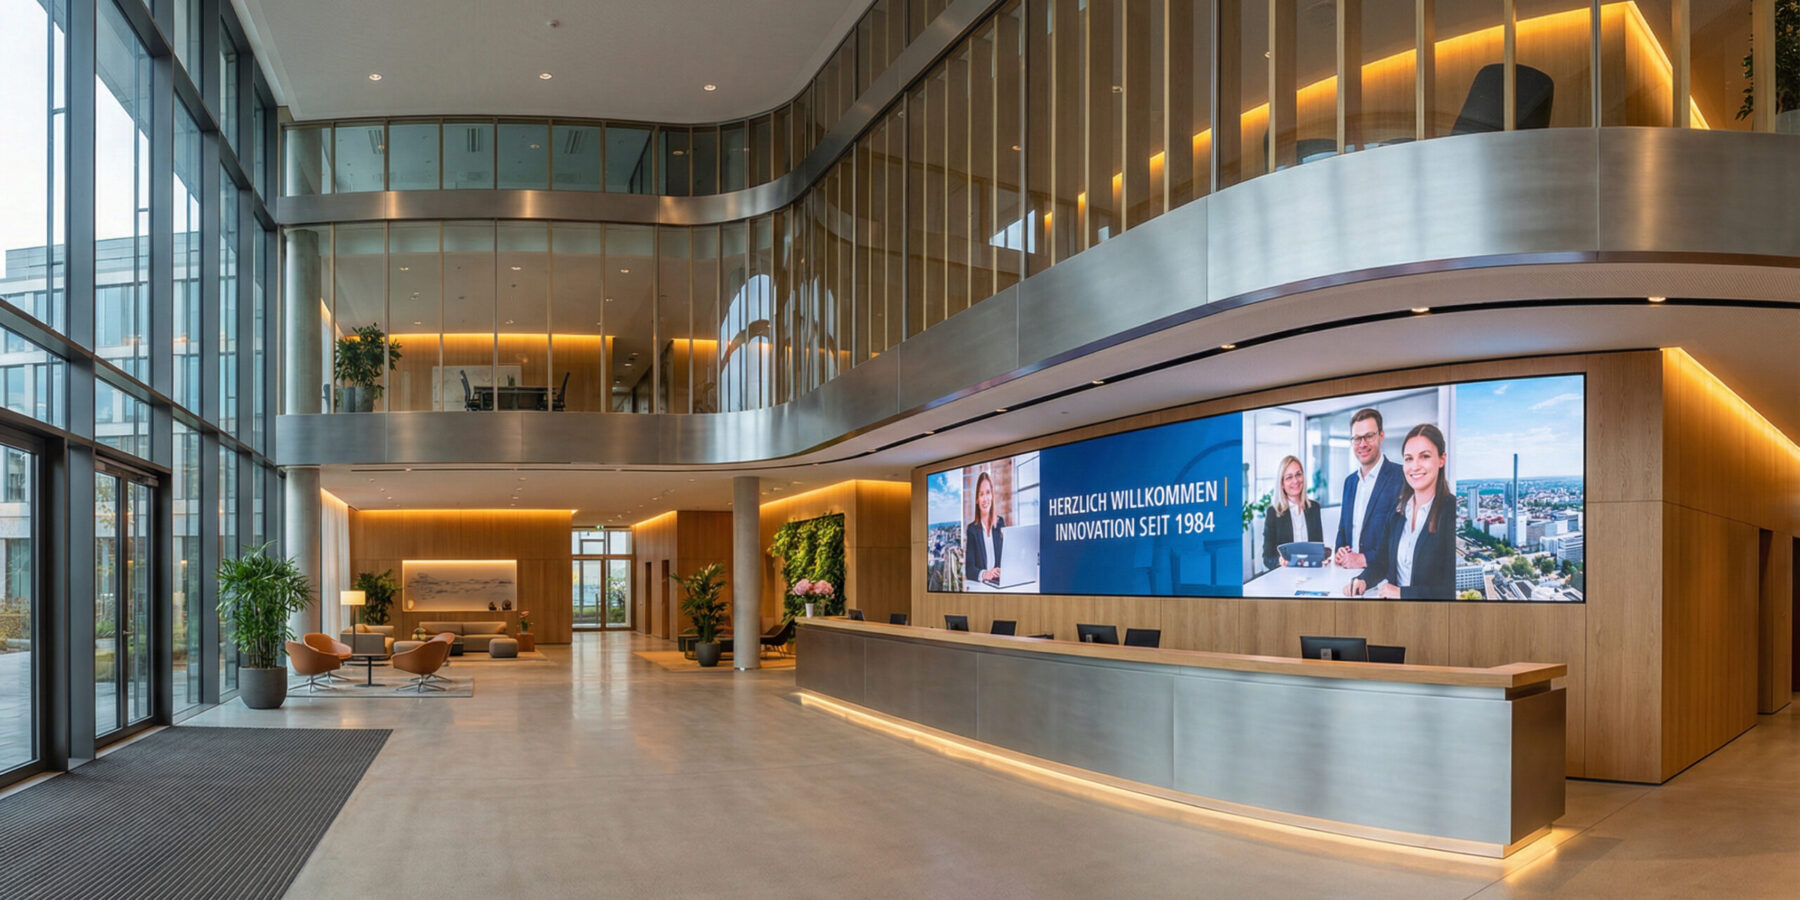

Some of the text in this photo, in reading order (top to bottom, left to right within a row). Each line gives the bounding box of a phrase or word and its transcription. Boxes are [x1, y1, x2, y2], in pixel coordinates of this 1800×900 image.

[1049, 480, 1218, 516] HERZLICH WILLKOMMEN
[1055, 511, 1216, 541] INNOVATION SEIT 1984
